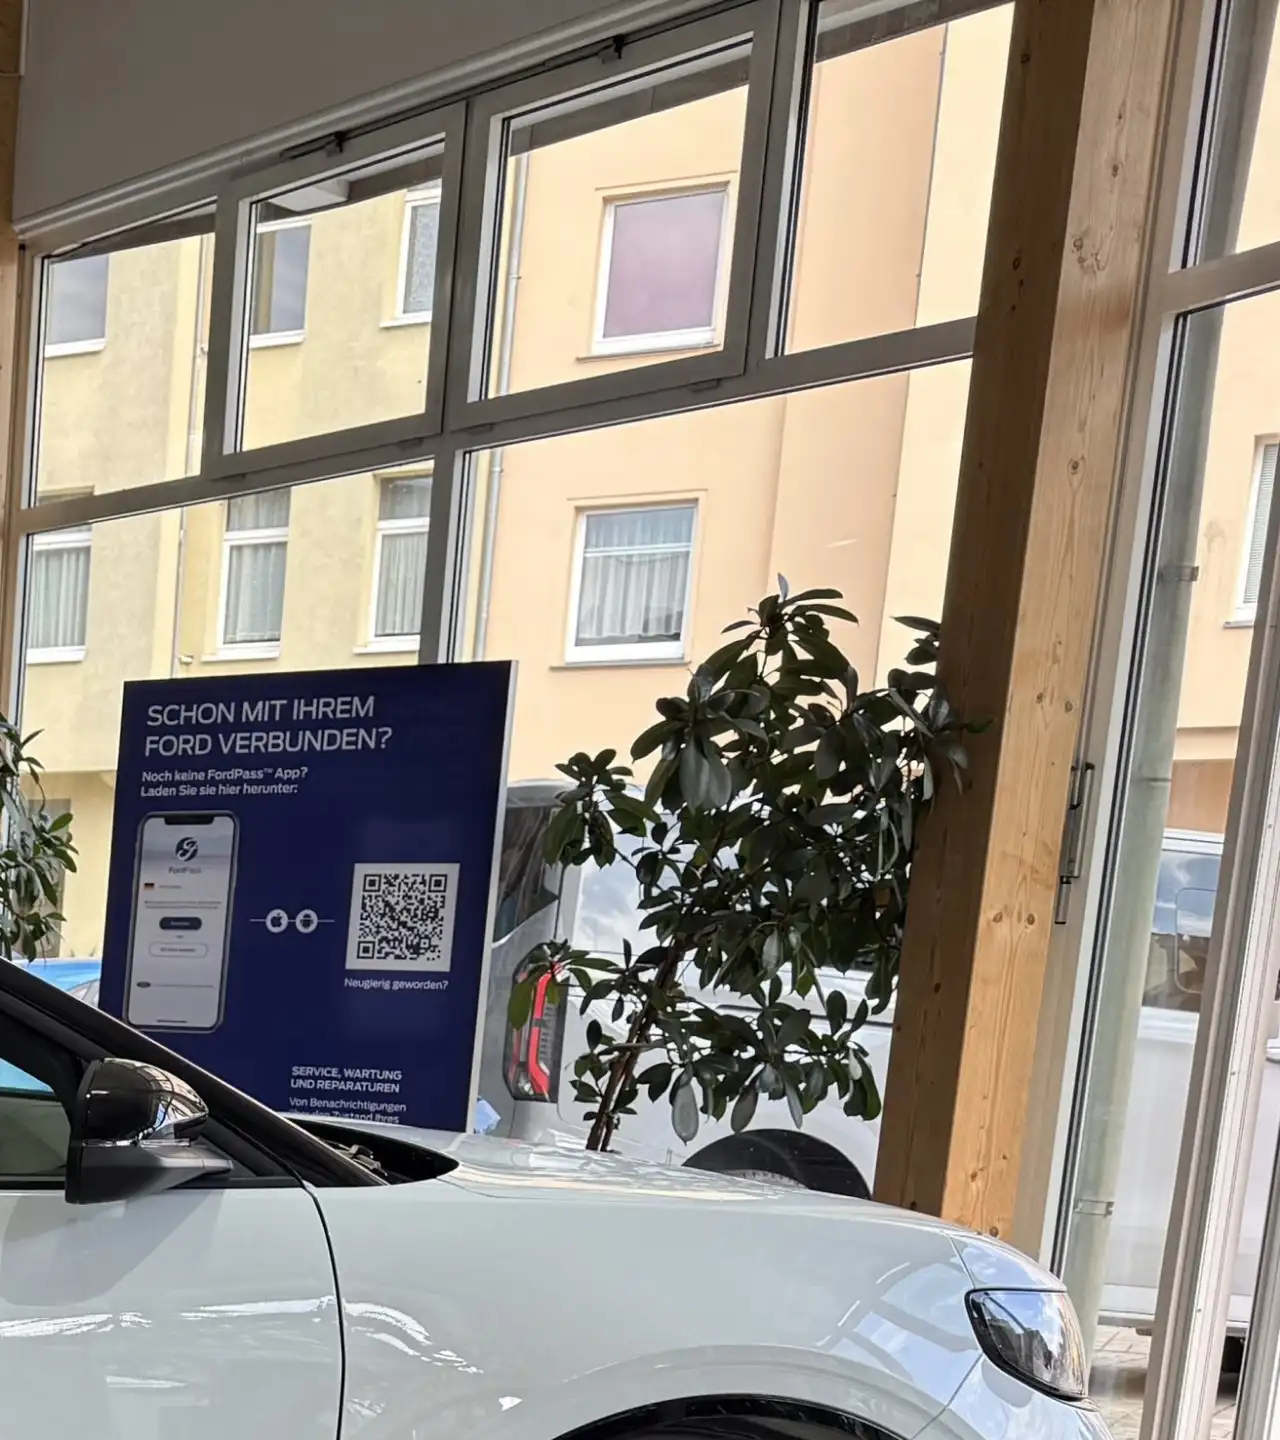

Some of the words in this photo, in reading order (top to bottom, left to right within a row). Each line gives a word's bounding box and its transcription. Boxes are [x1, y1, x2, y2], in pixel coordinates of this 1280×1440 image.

[146, 701, 236, 726] SCHON
[241, 699, 287, 722] MIT
[292, 695, 375, 720] IHREM
[145, 734, 212, 757] FORD
[218, 727, 393, 755] VERBUNDEN?
[142, 770, 172, 782] Noch
[174, 769, 206, 781] keine
[274, 766, 308, 781] App?
[141, 785, 177, 797] Laden
[179, 784, 197, 796] Sie
[199, 784, 216, 796] sie
[218, 783, 241, 795] hier
[243, 782, 299, 795] herunter:
[344, 977, 391, 990] Neugierig
[392, 979, 449, 991] geworden?
[291, 1066, 342, 1079] SERVICE,
[343, 1068, 403, 1081] WARTUNG
[290, 1079, 316, 1090] UND
[316, 1080, 401, 1093] REPARATUREN
[289, 1096, 308, 1107] Von
[309, 1097, 407, 1112] Benachrichtigungen
